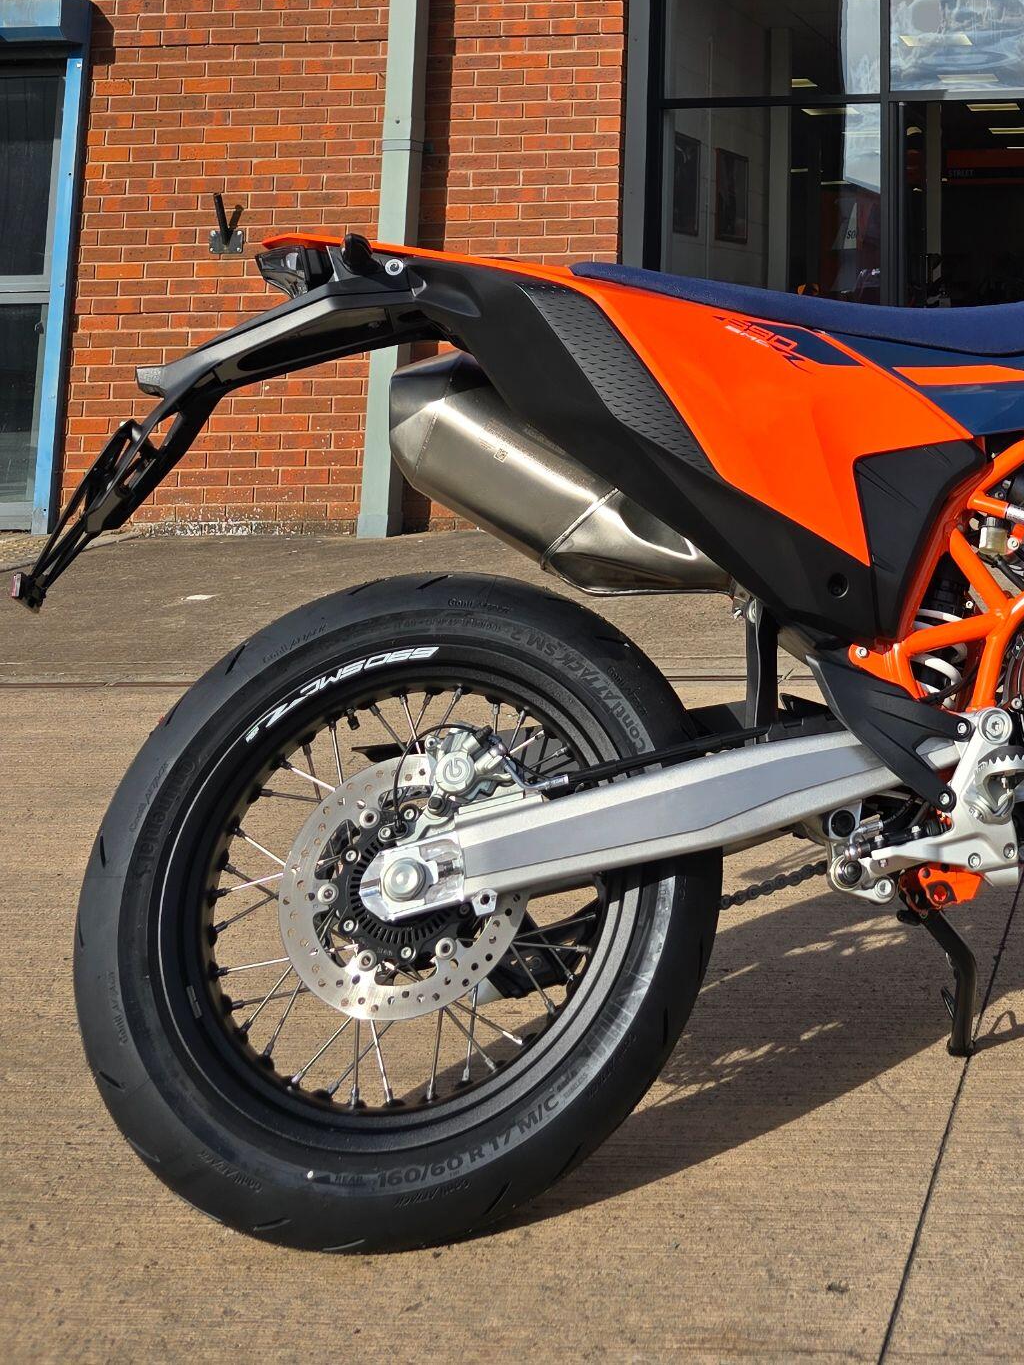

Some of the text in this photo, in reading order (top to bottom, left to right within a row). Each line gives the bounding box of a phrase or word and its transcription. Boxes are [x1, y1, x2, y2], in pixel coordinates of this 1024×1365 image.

[376, 1157, 464, 1188] 160/60
[469, 1144, 486, 1164] R
[491, 1127, 514, 1152] 17
